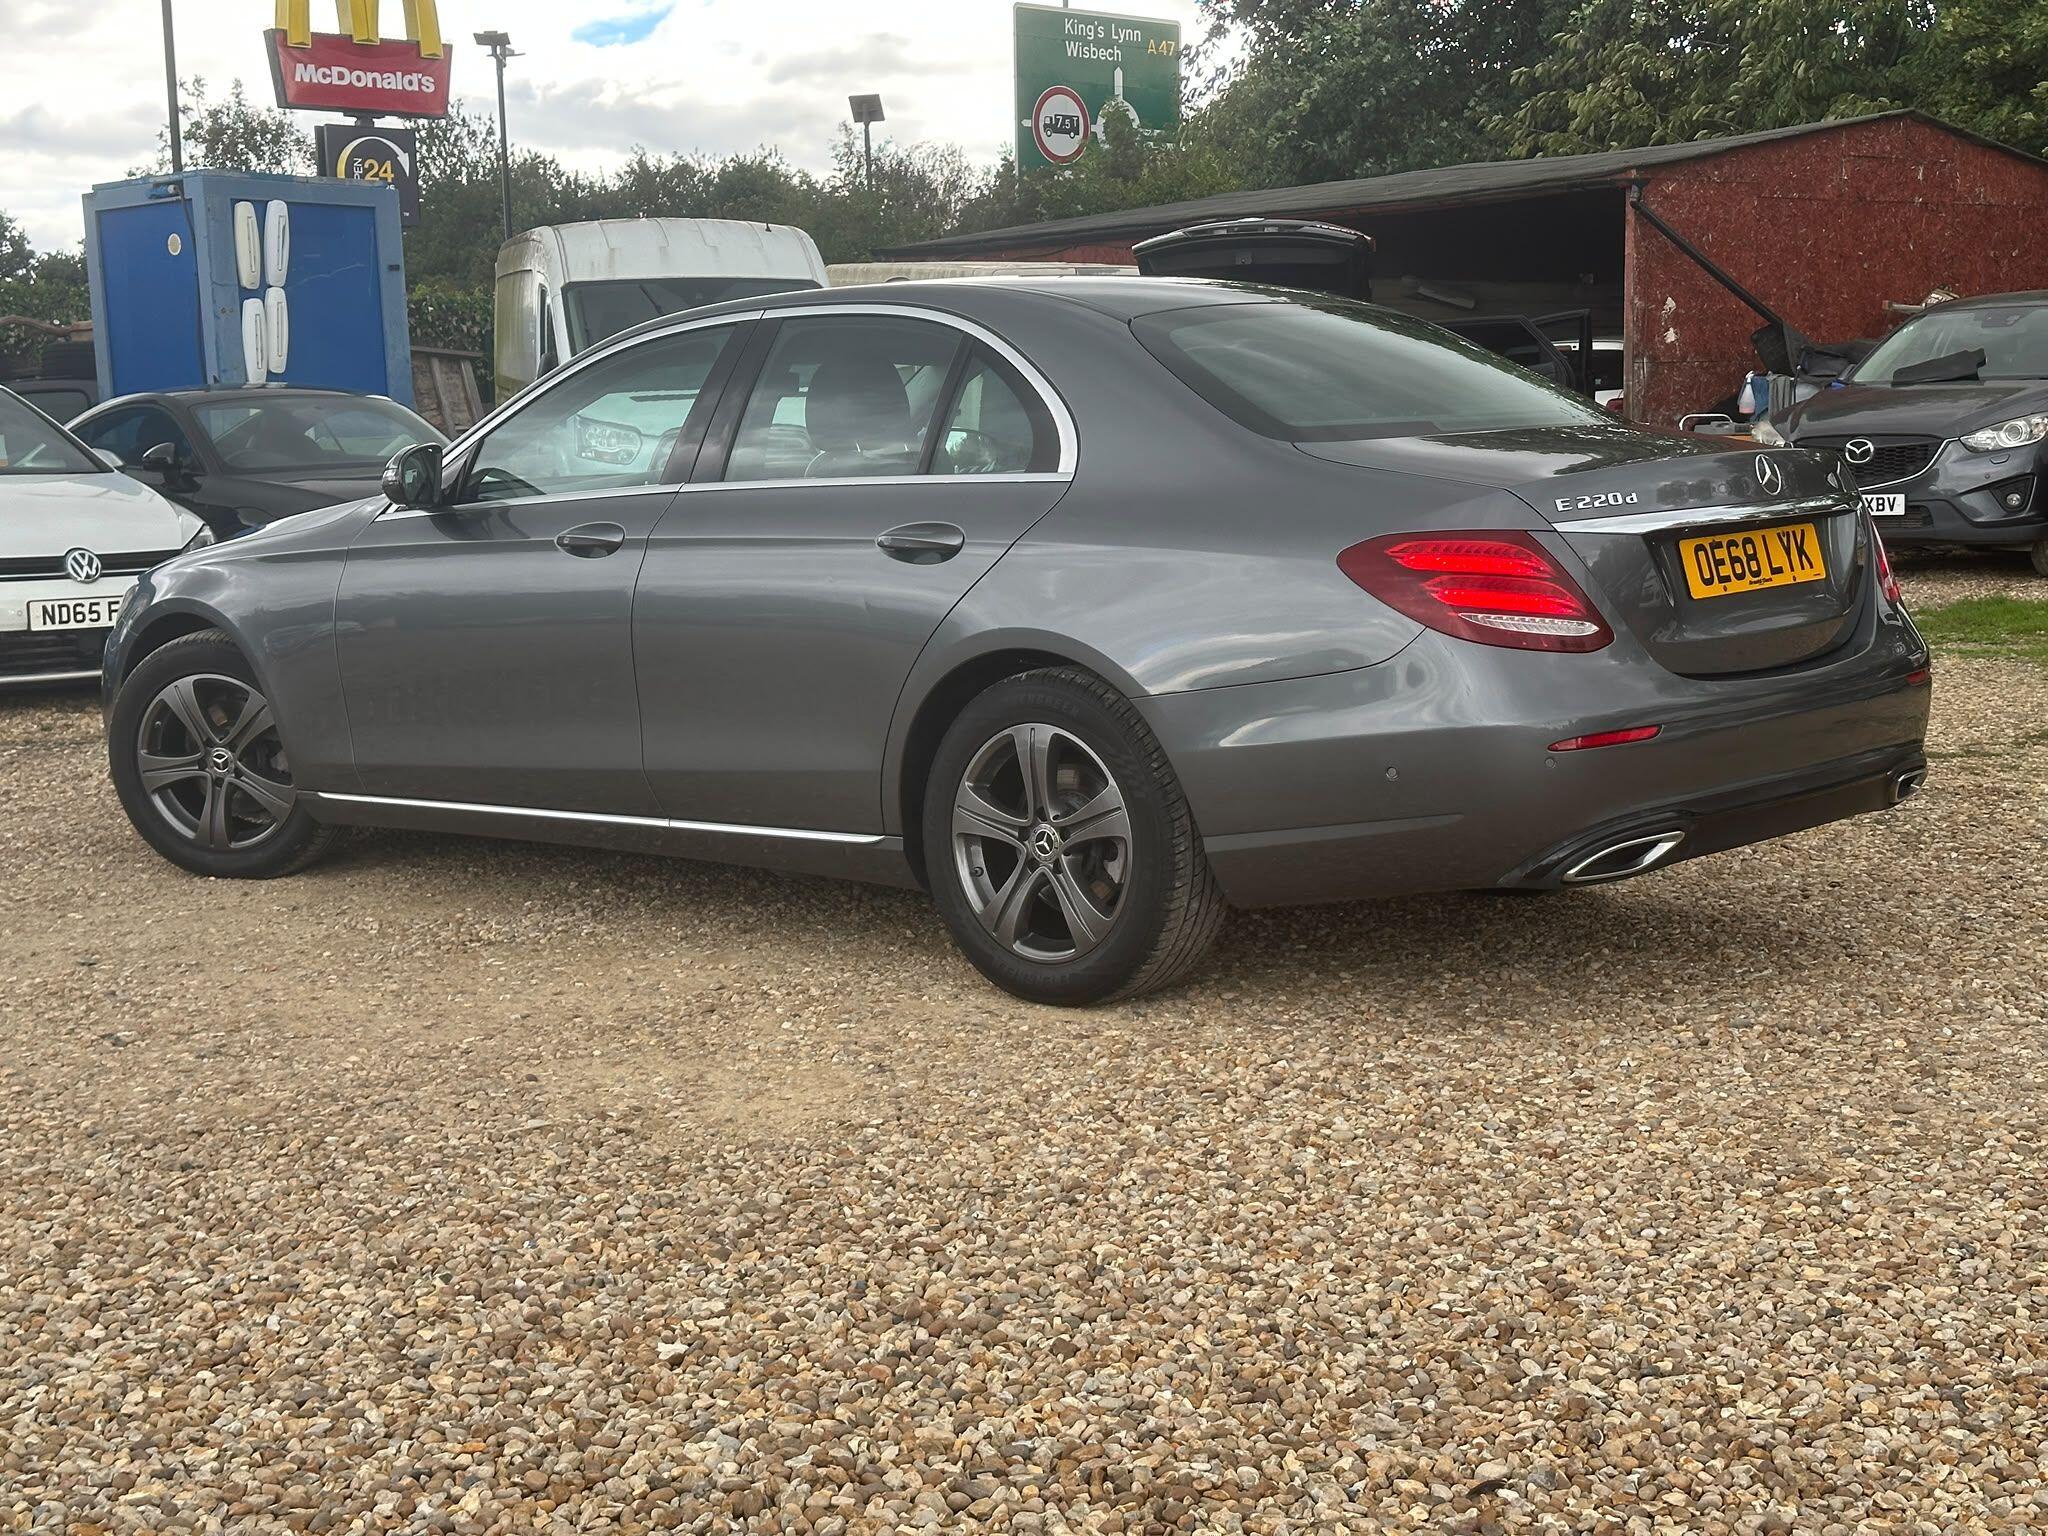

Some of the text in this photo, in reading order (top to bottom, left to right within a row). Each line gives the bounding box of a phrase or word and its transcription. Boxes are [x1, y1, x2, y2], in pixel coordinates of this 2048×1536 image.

[1064, 18, 1142, 43] King's Lynn
[1065, 41, 1122, 61] Wisbech
[1147, 39, 1176, 57] A47
[295, 63, 435, 93] McDonald's
[363, 158, 394, 183] 24
[1554, 491, 1639, 512] E 220d
[1693, 528, 1814, 587] OE68 LYK
[42, 602, 100, 625] ND65
